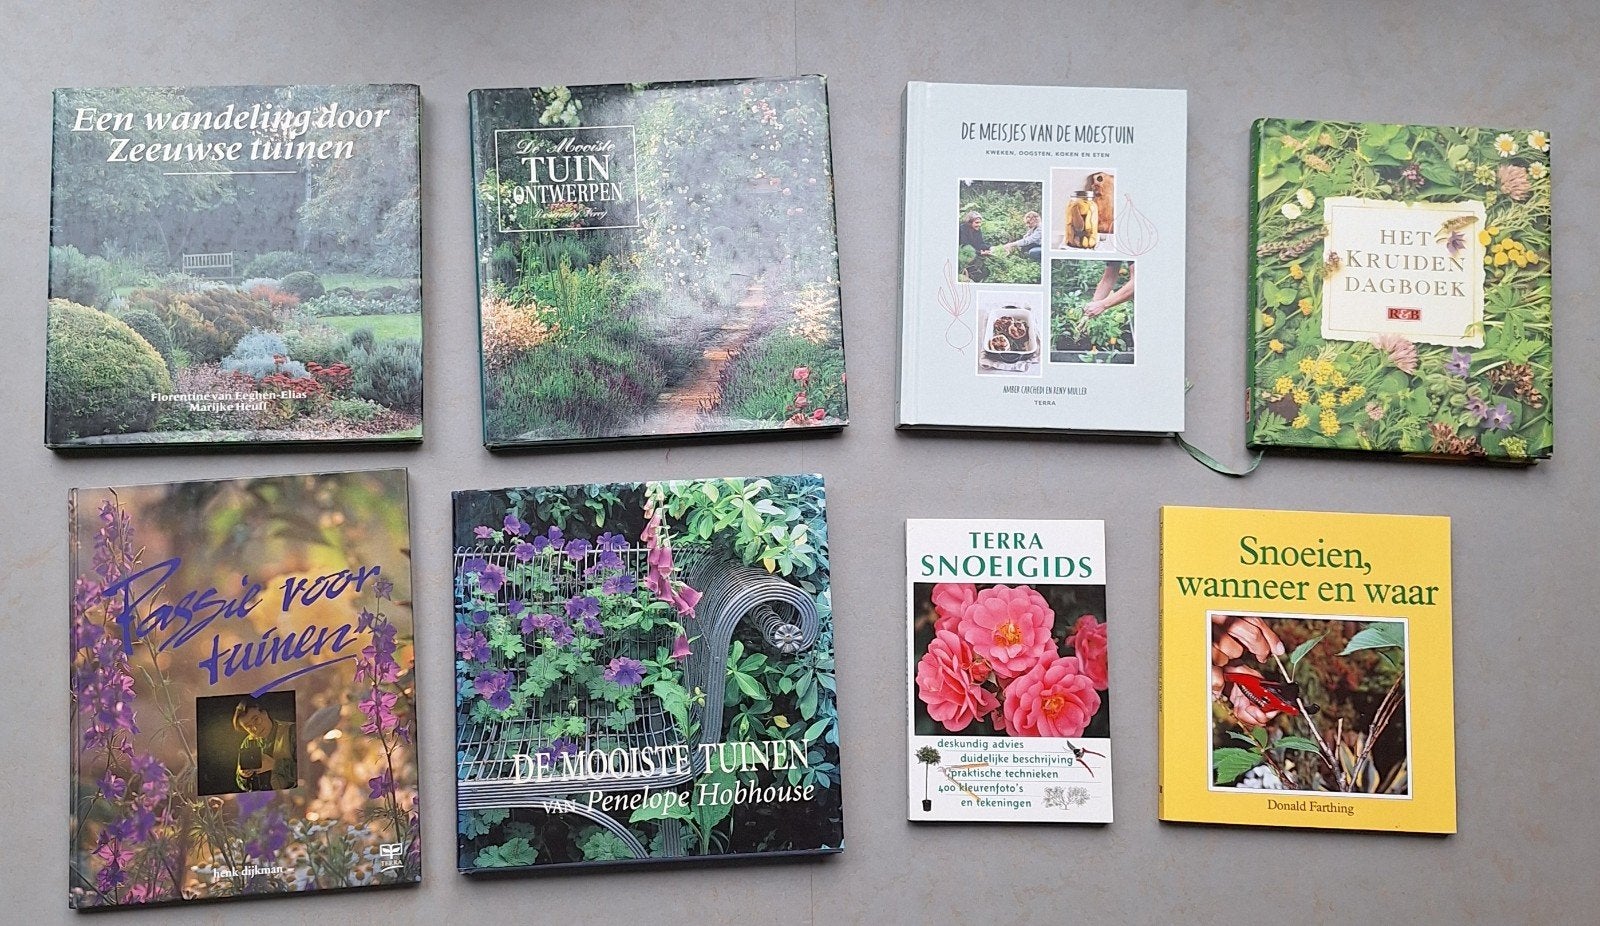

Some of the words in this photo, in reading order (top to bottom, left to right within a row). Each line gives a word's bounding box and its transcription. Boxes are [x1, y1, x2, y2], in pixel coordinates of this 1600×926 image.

[71, 107, 133, 132] Een
[145, 102, 313, 135] wandeling
[315, 102, 390, 129] door
[961, 121, 976, 140] DE
[979, 122, 1027, 143] MEISJES
[1030, 124, 1053, 142] VAN
[1056, 124, 1071, 143] DE
[1075, 124, 1134, 144] MOESTUIN
[107, 138, 242, 162] Zeeuwse
[250, 136, 354, 161] tuinen
[516, 139, 540, 154] De
[547, 137, 615, 154] Mooiste
[521, 154, 611, 183] TUIN
[513, 182, 624, 204] ONTWERPEN
[1380, 229, 1431, 246] HET
[1346, 249, 1465, 272] KRUIDEN
[1344, 276, 1465, 297] DAGBOEK
[1389, 308, 1421, 320] R&B
[151, 392, 210, 402] Florentine
[212, 393, 228, 401] van
[235, 390, 307, 402] Eeghen-Elias
[1003, 385, 1020, 394] AMBER
[1045, 386, 1052, 395] EN
[1067, 387, 1087, 396] MULLER
[189, 402, 233, 413] Marijke
[968, 531, 1044, 550] TERRA
[1240, 535, 1371, 576] Snoeien,
[921, 554, 1093, 579] SNOEIGIDS
[1176, 575, 1310, 601] wanneer
[1317, 582, 1356, 602] en
[1363, 582, 1439, 606] waar
[103, 557, 263, 656] Passie
[279, 565, 381, 612] voor
[198, 623, 359, 686] tuinen
[937, 739, 989, 751] deskundig
[992, 739, 1024, 749] advies
[511, 751, 551, 784] DE
[560, 744, 691, 782] MOOISTE
[698, 738, 810, 774] TUINEN
[960, 754, 1009, 765] duidelijke
[1012, 754, 1074, 767] beschrijving
[950, 768, 1001, 780] praktische
[1005, 769, 1059, 779] technieken
[542, 799, 577, 814] VAN
[587, 784, 690, 815] Penelope
[698, 779, 815, 807] Hobhouse
[938, 784, 956, 793] 400
[959, 782, 1024, 794] kleurenfoto's
[976, 798, 1032, 810] tekeningen
[1267, 799, 1307, 812] Donald
[1309, 801, 1355, 816] Farthing
[213, 868, 239, 879] henk
[241, 865, 283, 880] dijkman
[381, 859, 403, 867] TERRA
